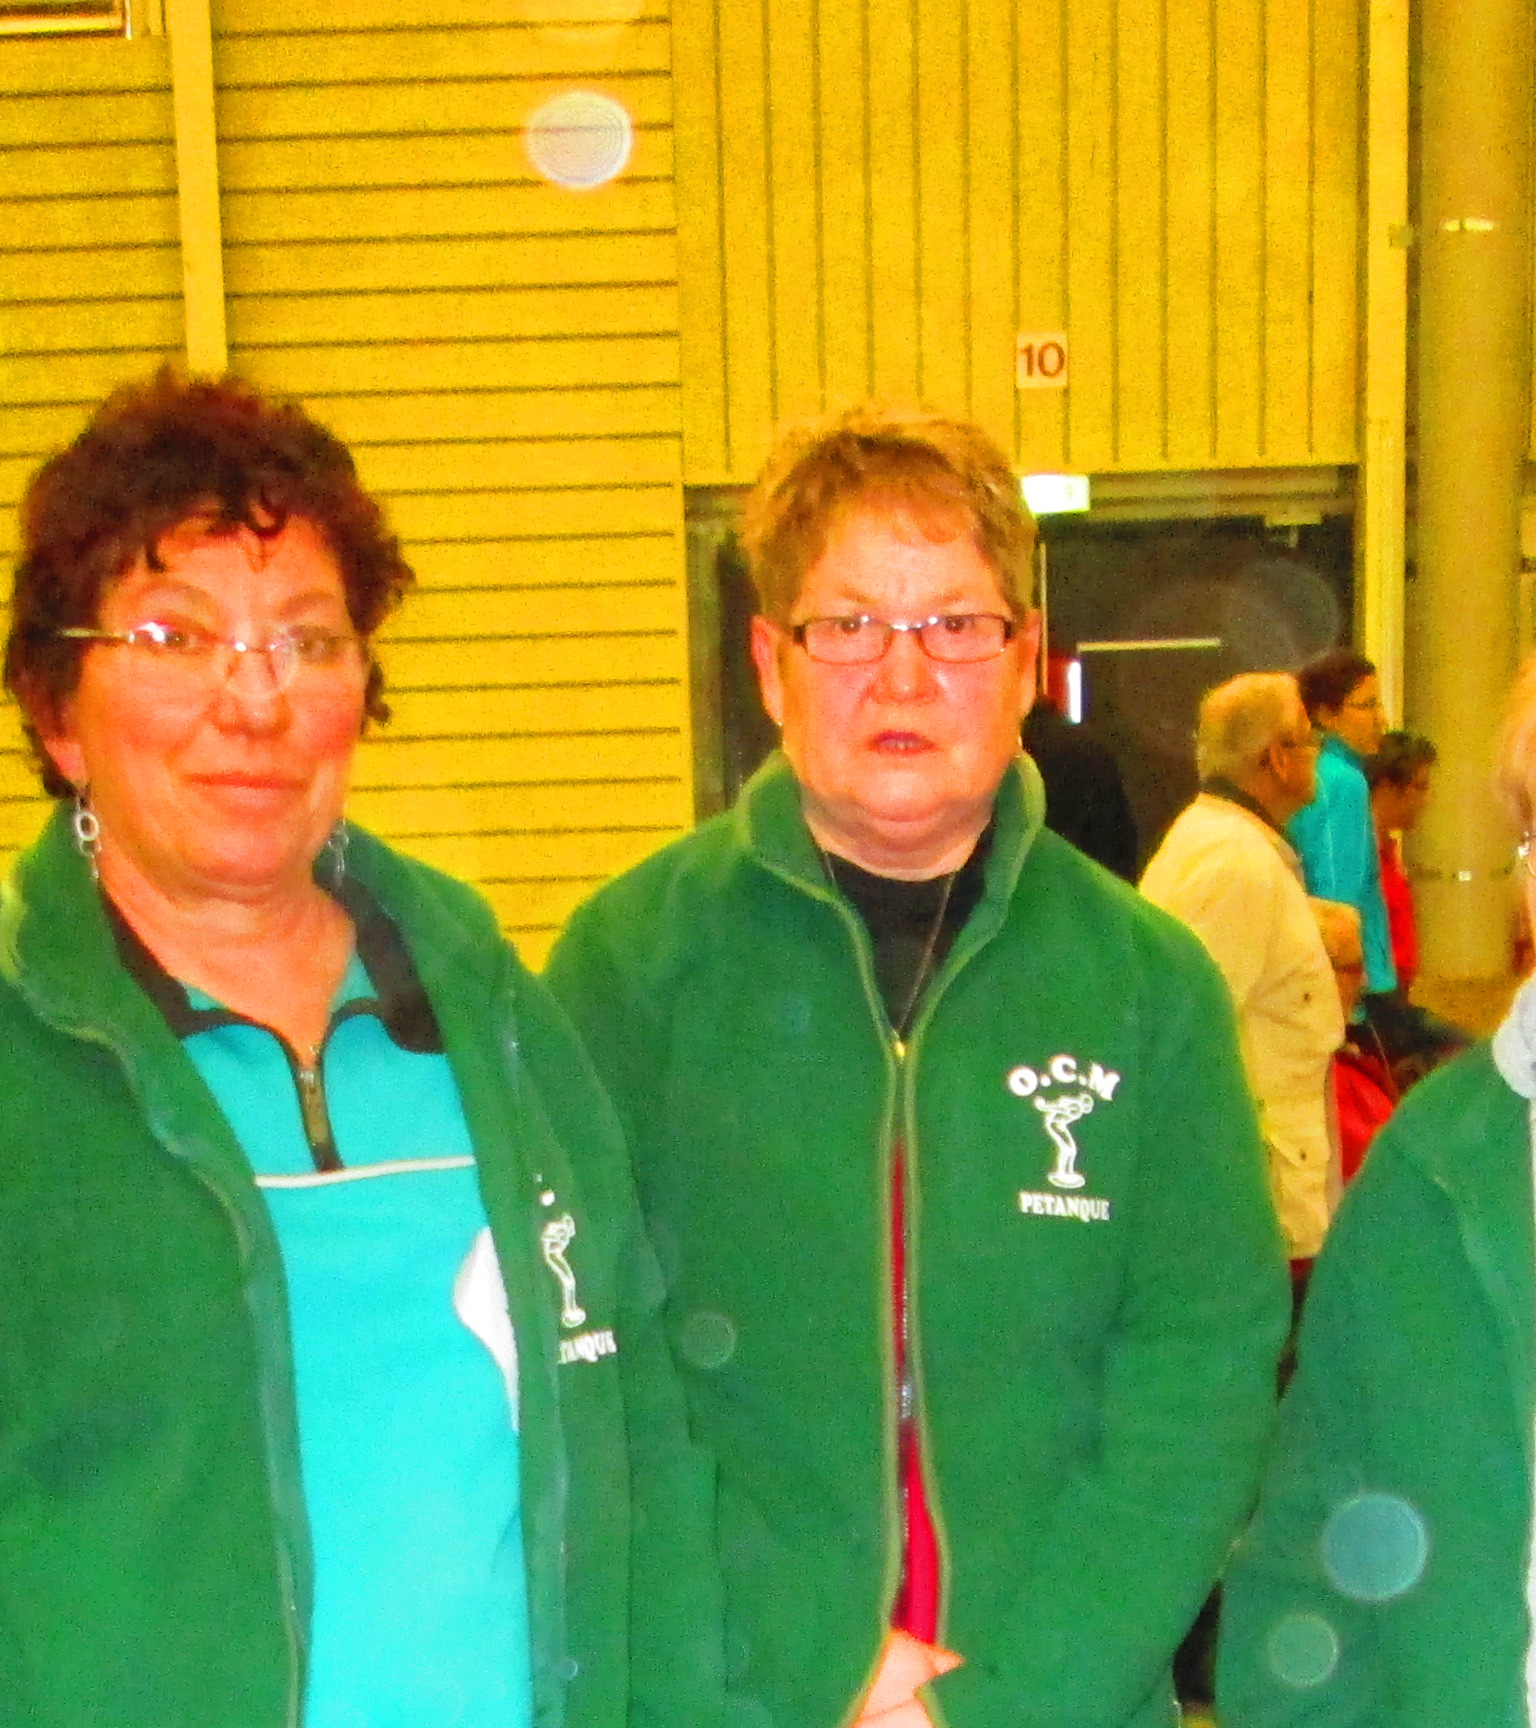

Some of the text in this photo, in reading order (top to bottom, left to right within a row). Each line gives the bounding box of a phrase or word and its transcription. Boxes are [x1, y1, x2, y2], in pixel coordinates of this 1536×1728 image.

[1019, 342, 1065, 377] 10
[1007, 1053, 1121, 1101] O.C.M
[1018, 1191, 1110, 1223] PETANQUE
